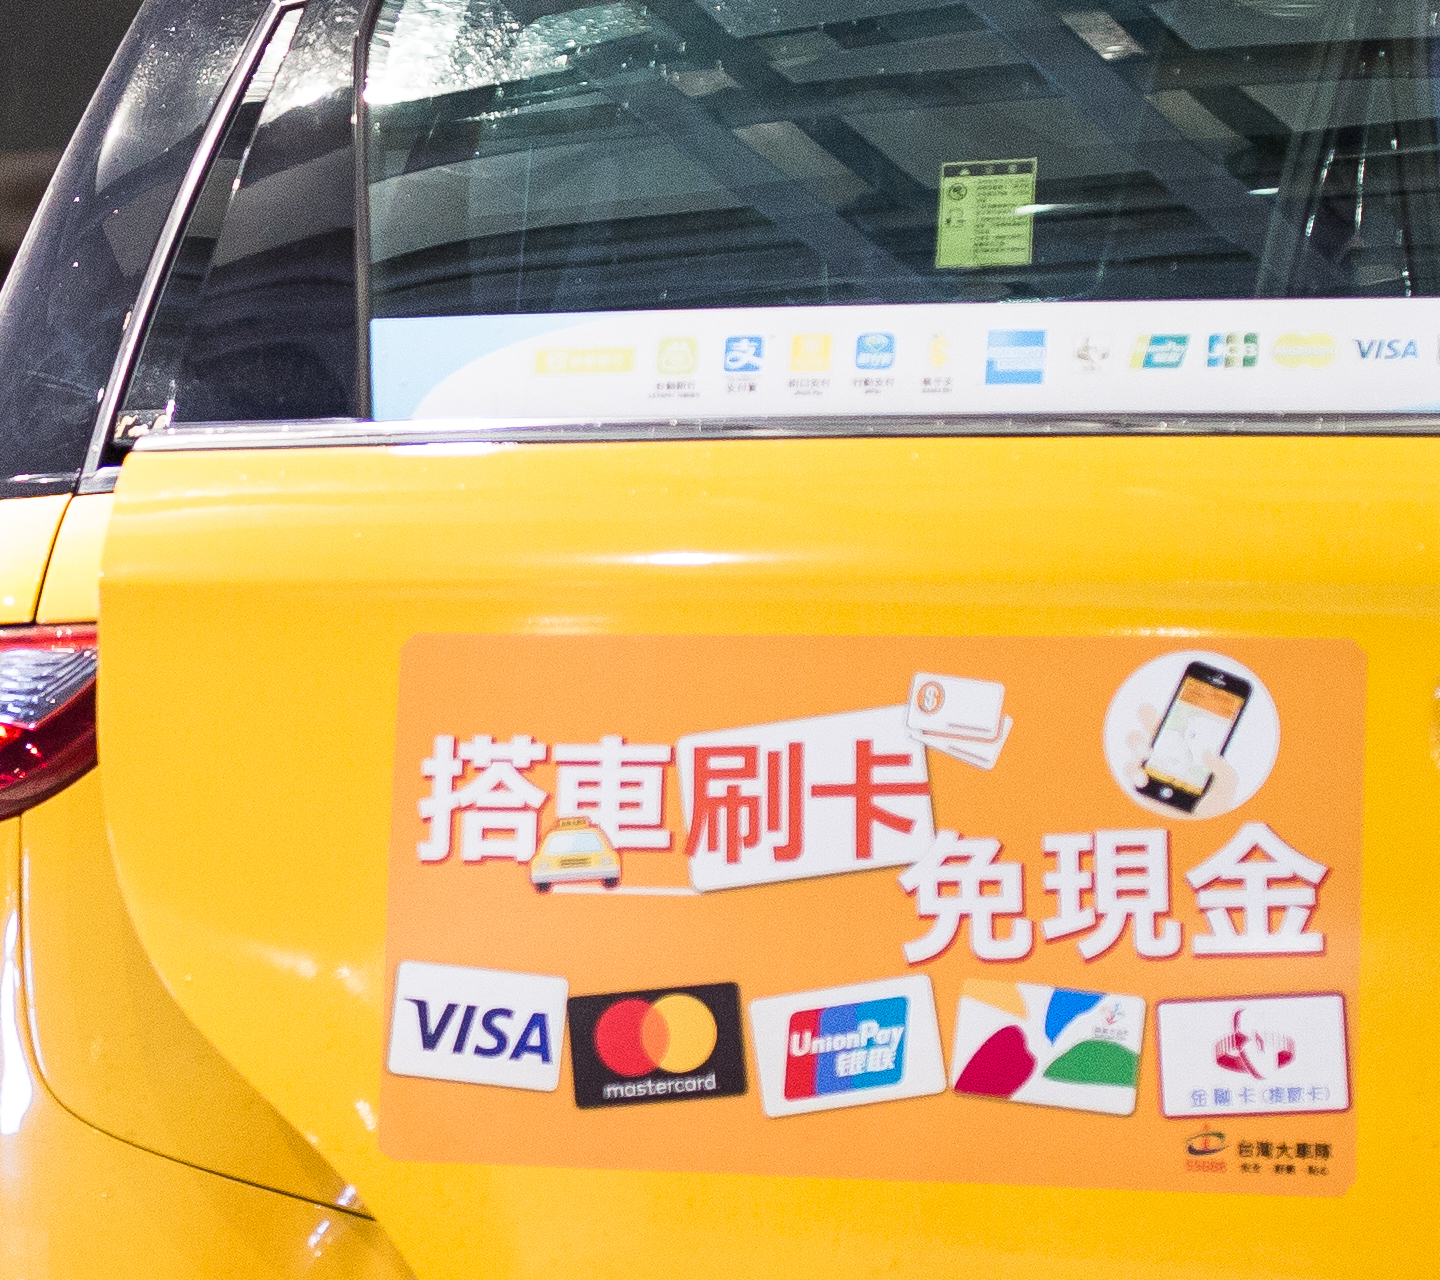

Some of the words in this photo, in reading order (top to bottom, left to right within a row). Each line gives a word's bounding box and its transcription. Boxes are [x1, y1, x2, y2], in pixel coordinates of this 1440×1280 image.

[1352, 337, 1420, 361] VISA
[415, 732, 931, 865] 搭車刷卡
[900, 821, 1329, 964] 免現金
[404, 998, 553, 1065] VISA
[790, 1019, 905, 1057] UnionPay
[603, 1072, 717, 1100] mastercard
